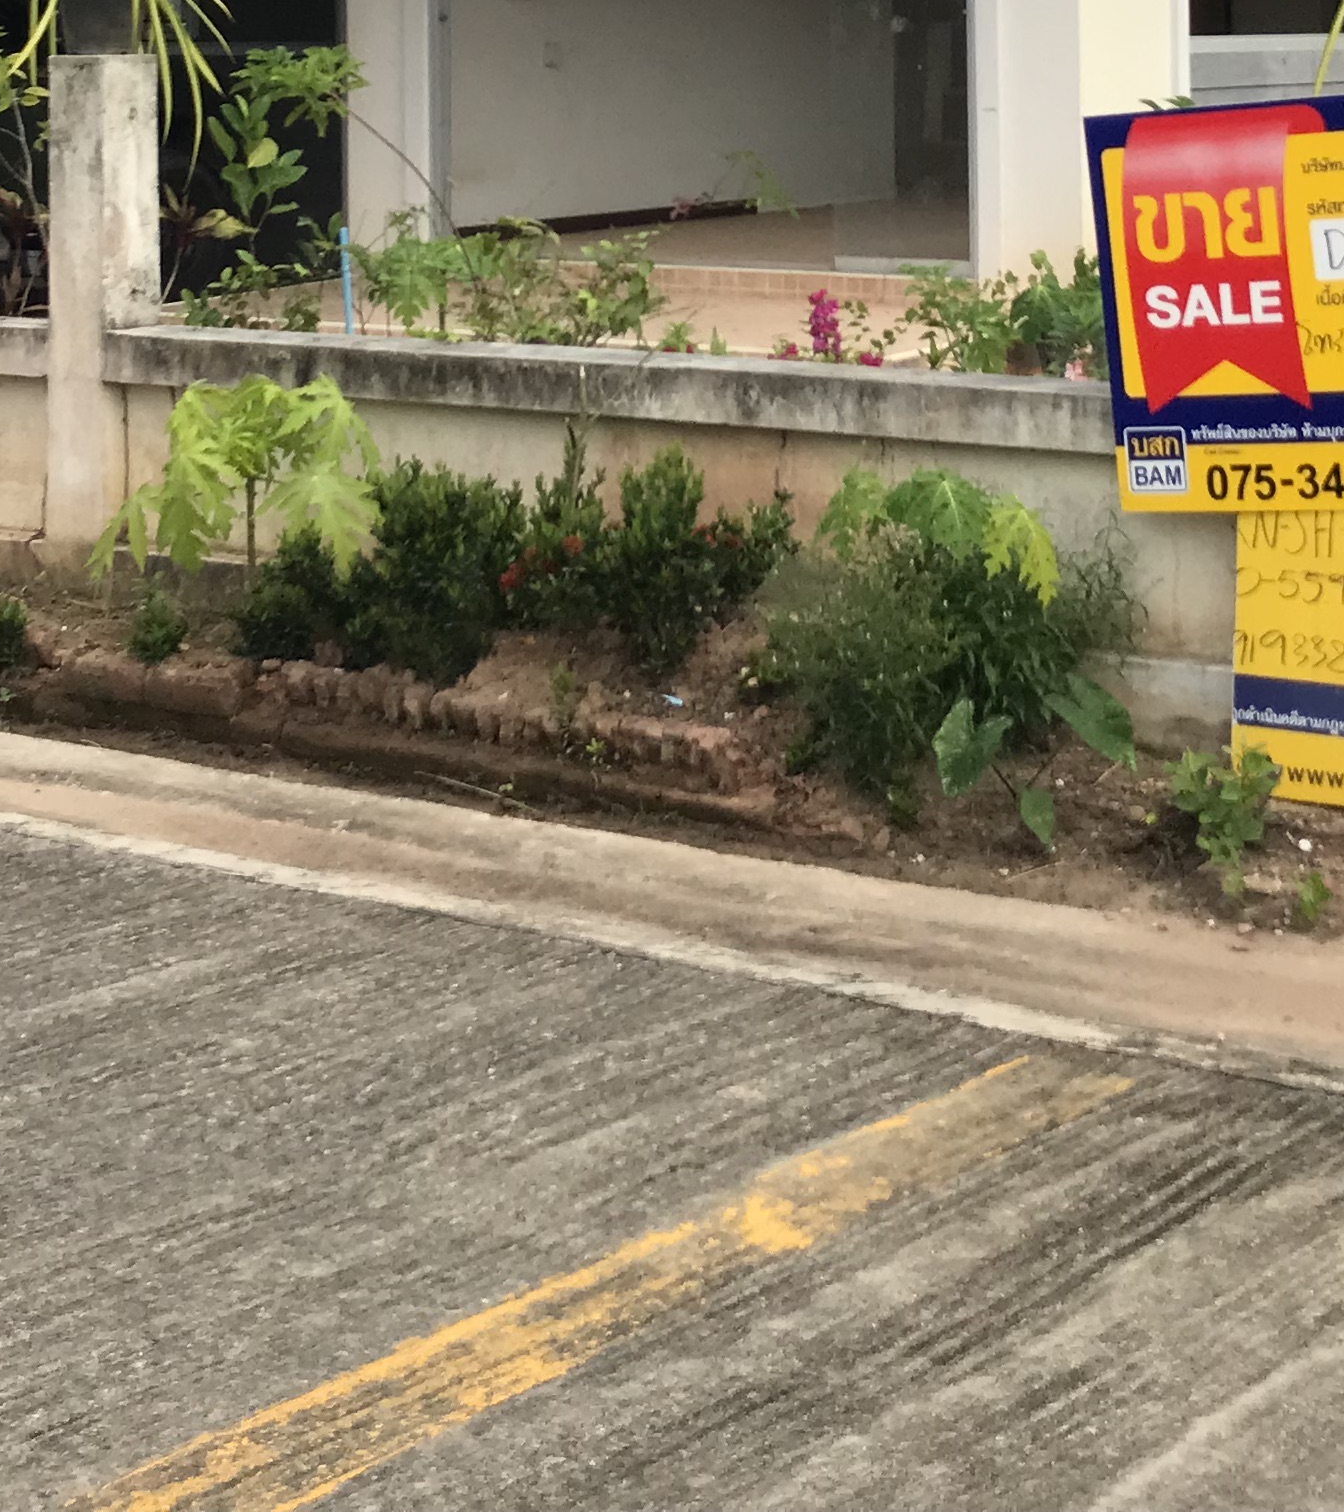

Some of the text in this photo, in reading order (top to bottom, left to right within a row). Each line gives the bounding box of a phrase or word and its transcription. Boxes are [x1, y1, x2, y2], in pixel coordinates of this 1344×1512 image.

[1132, 185, 1282, 264] ขาย
[1144, 279, 1285, 329] SALE
[1130, 434, 1181, 458] บสก
[1133, 464, 1183, 488] BAM
